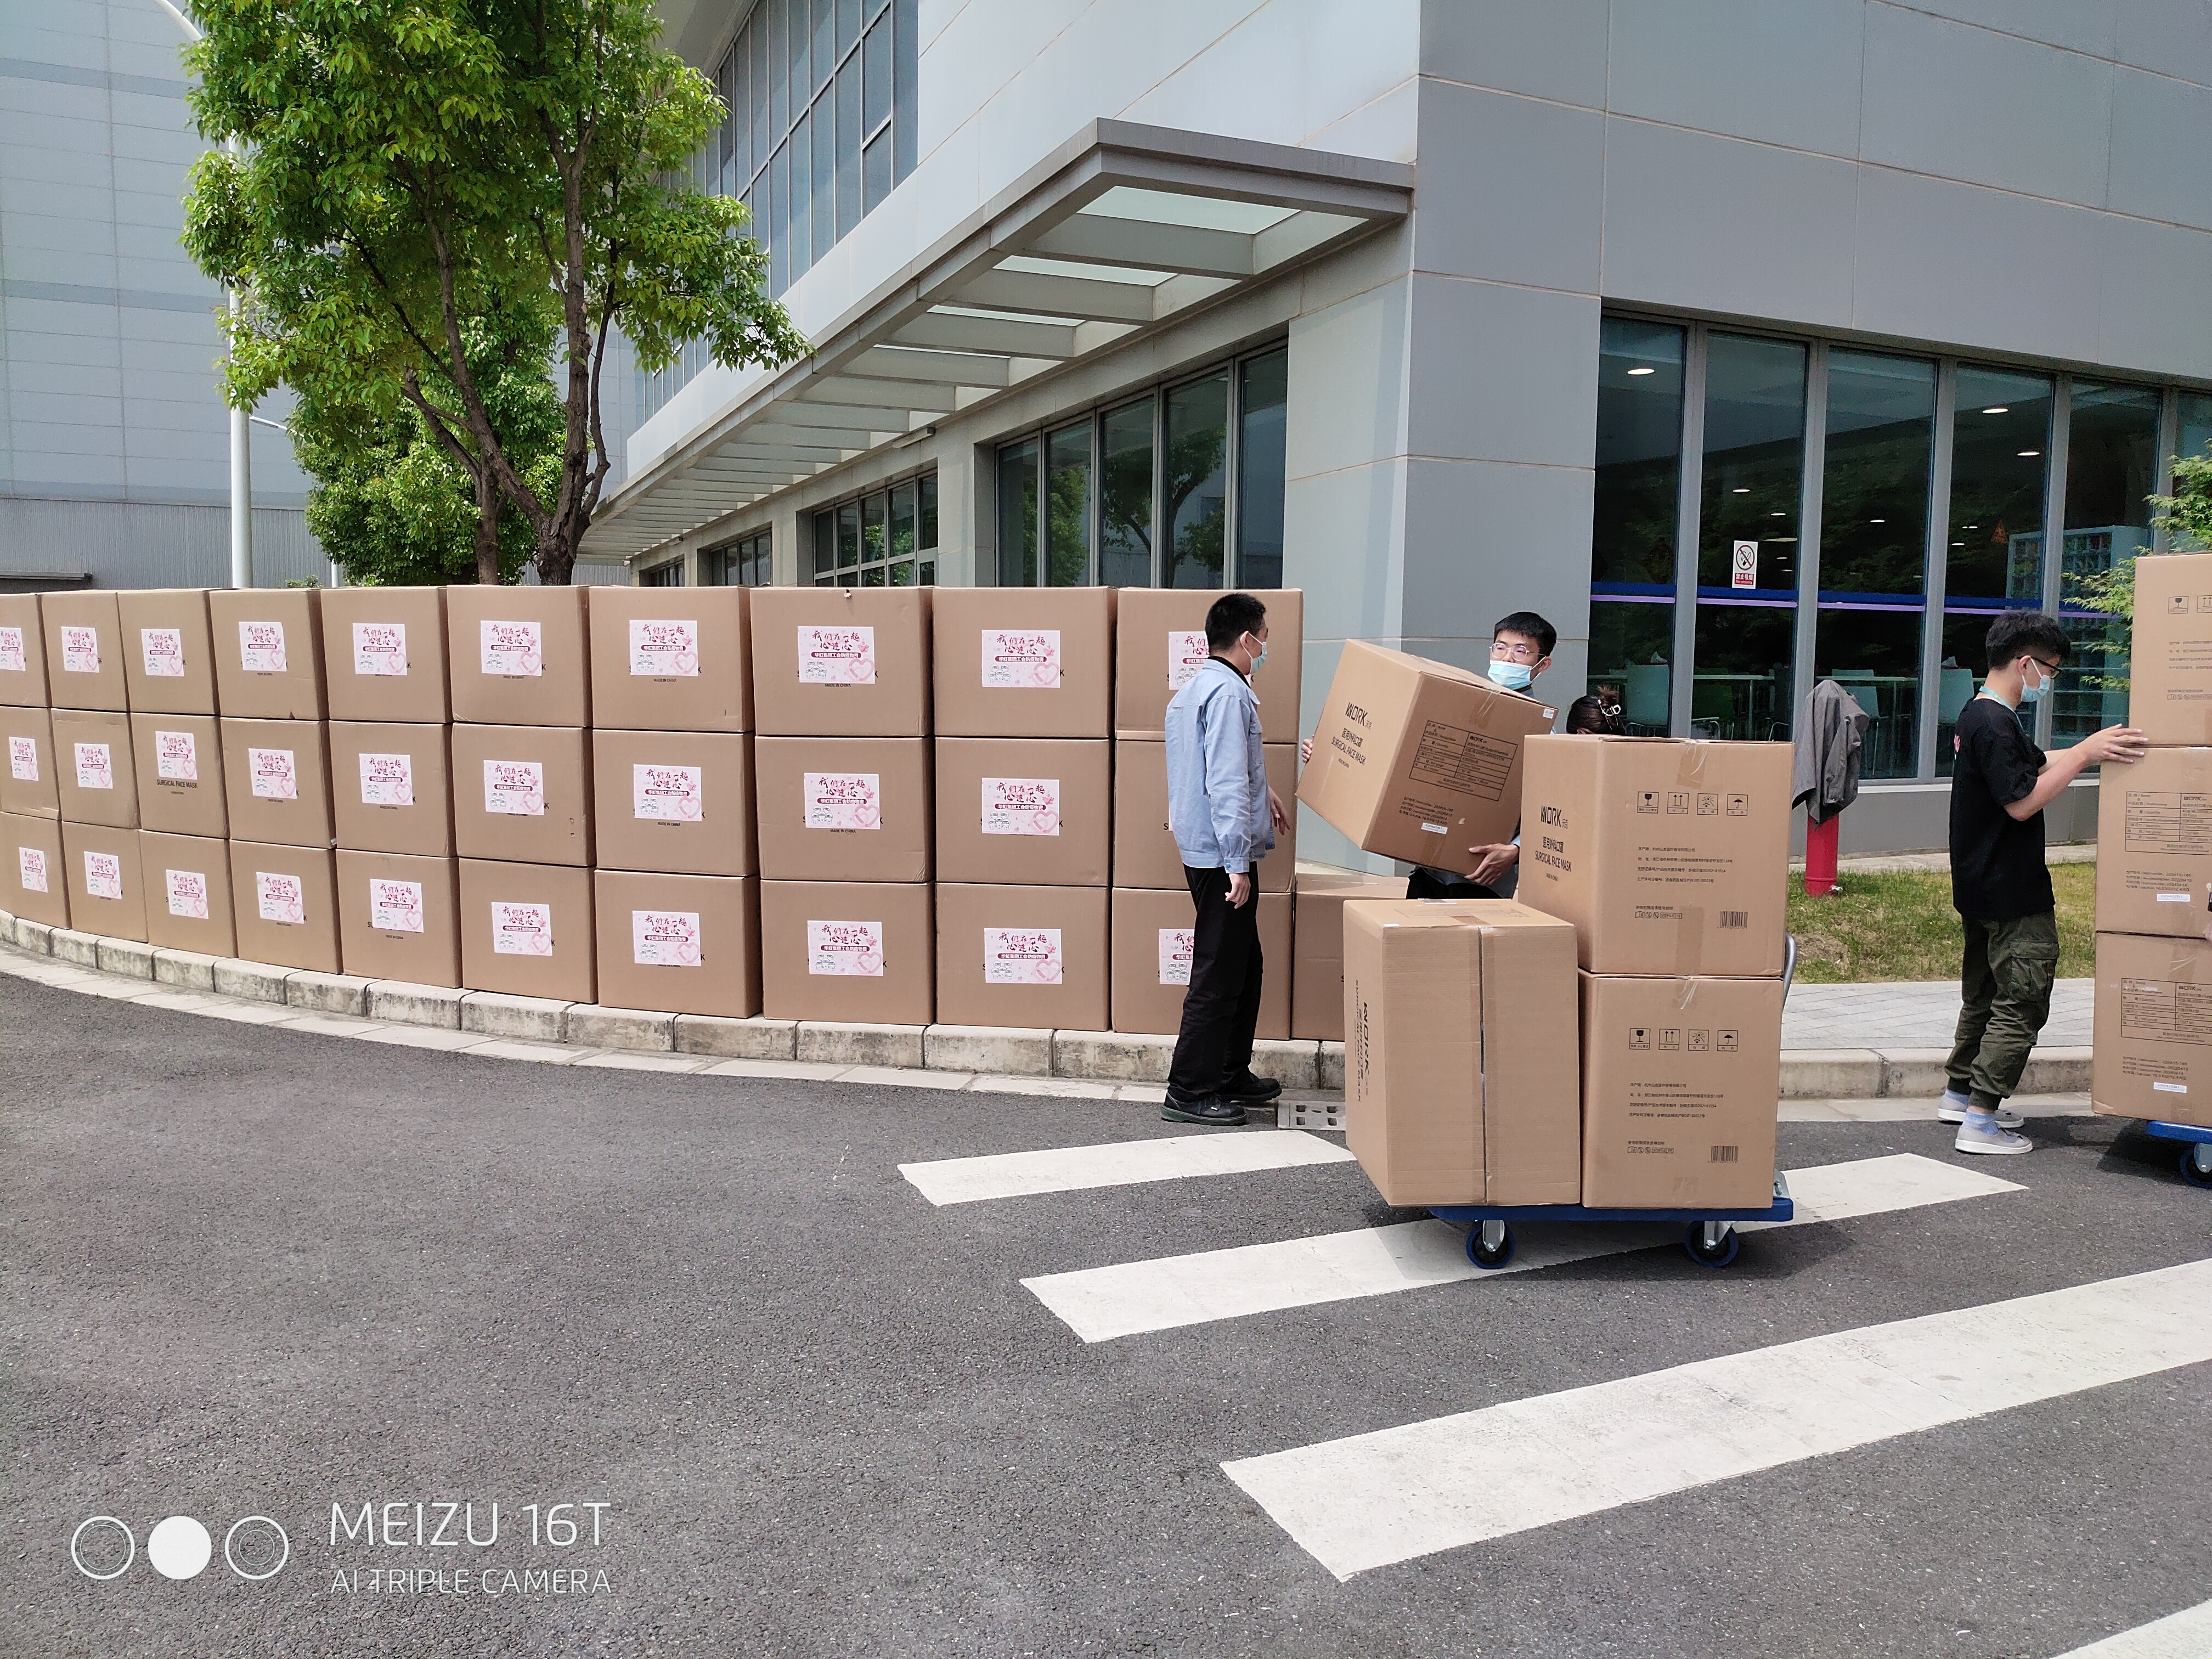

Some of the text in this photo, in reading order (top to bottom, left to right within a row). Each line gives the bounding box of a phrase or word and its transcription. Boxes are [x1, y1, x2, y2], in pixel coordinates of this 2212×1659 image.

[642, 624, 684, 636] 我们在一起
[812, 630, 859, 643] 我们在一起
[997, 634, 1045, 647] 我们在一起
[1345, 702, 1368, 726] WORK
[1331, 736, 1346, 753] SURGICAL
[1346, 747, 1356, 759] FACE
[1355, 753, 1367, 766] MASK
[646, 769, 688, 781] 我们在一起
[818, 777, 865, 789] 我们在一起
[996, 782, 1044, 795] 我们在一起
[1541, 805, 1562, 827] WORK
[1535, 850, 1572, 873] SURGICAL FACE MASK
[645, 915, 686, 927] 我们在一起
[822, 924, 867, 937] 我们在一起
[998, 932, 1046, 945] 我们在一起
